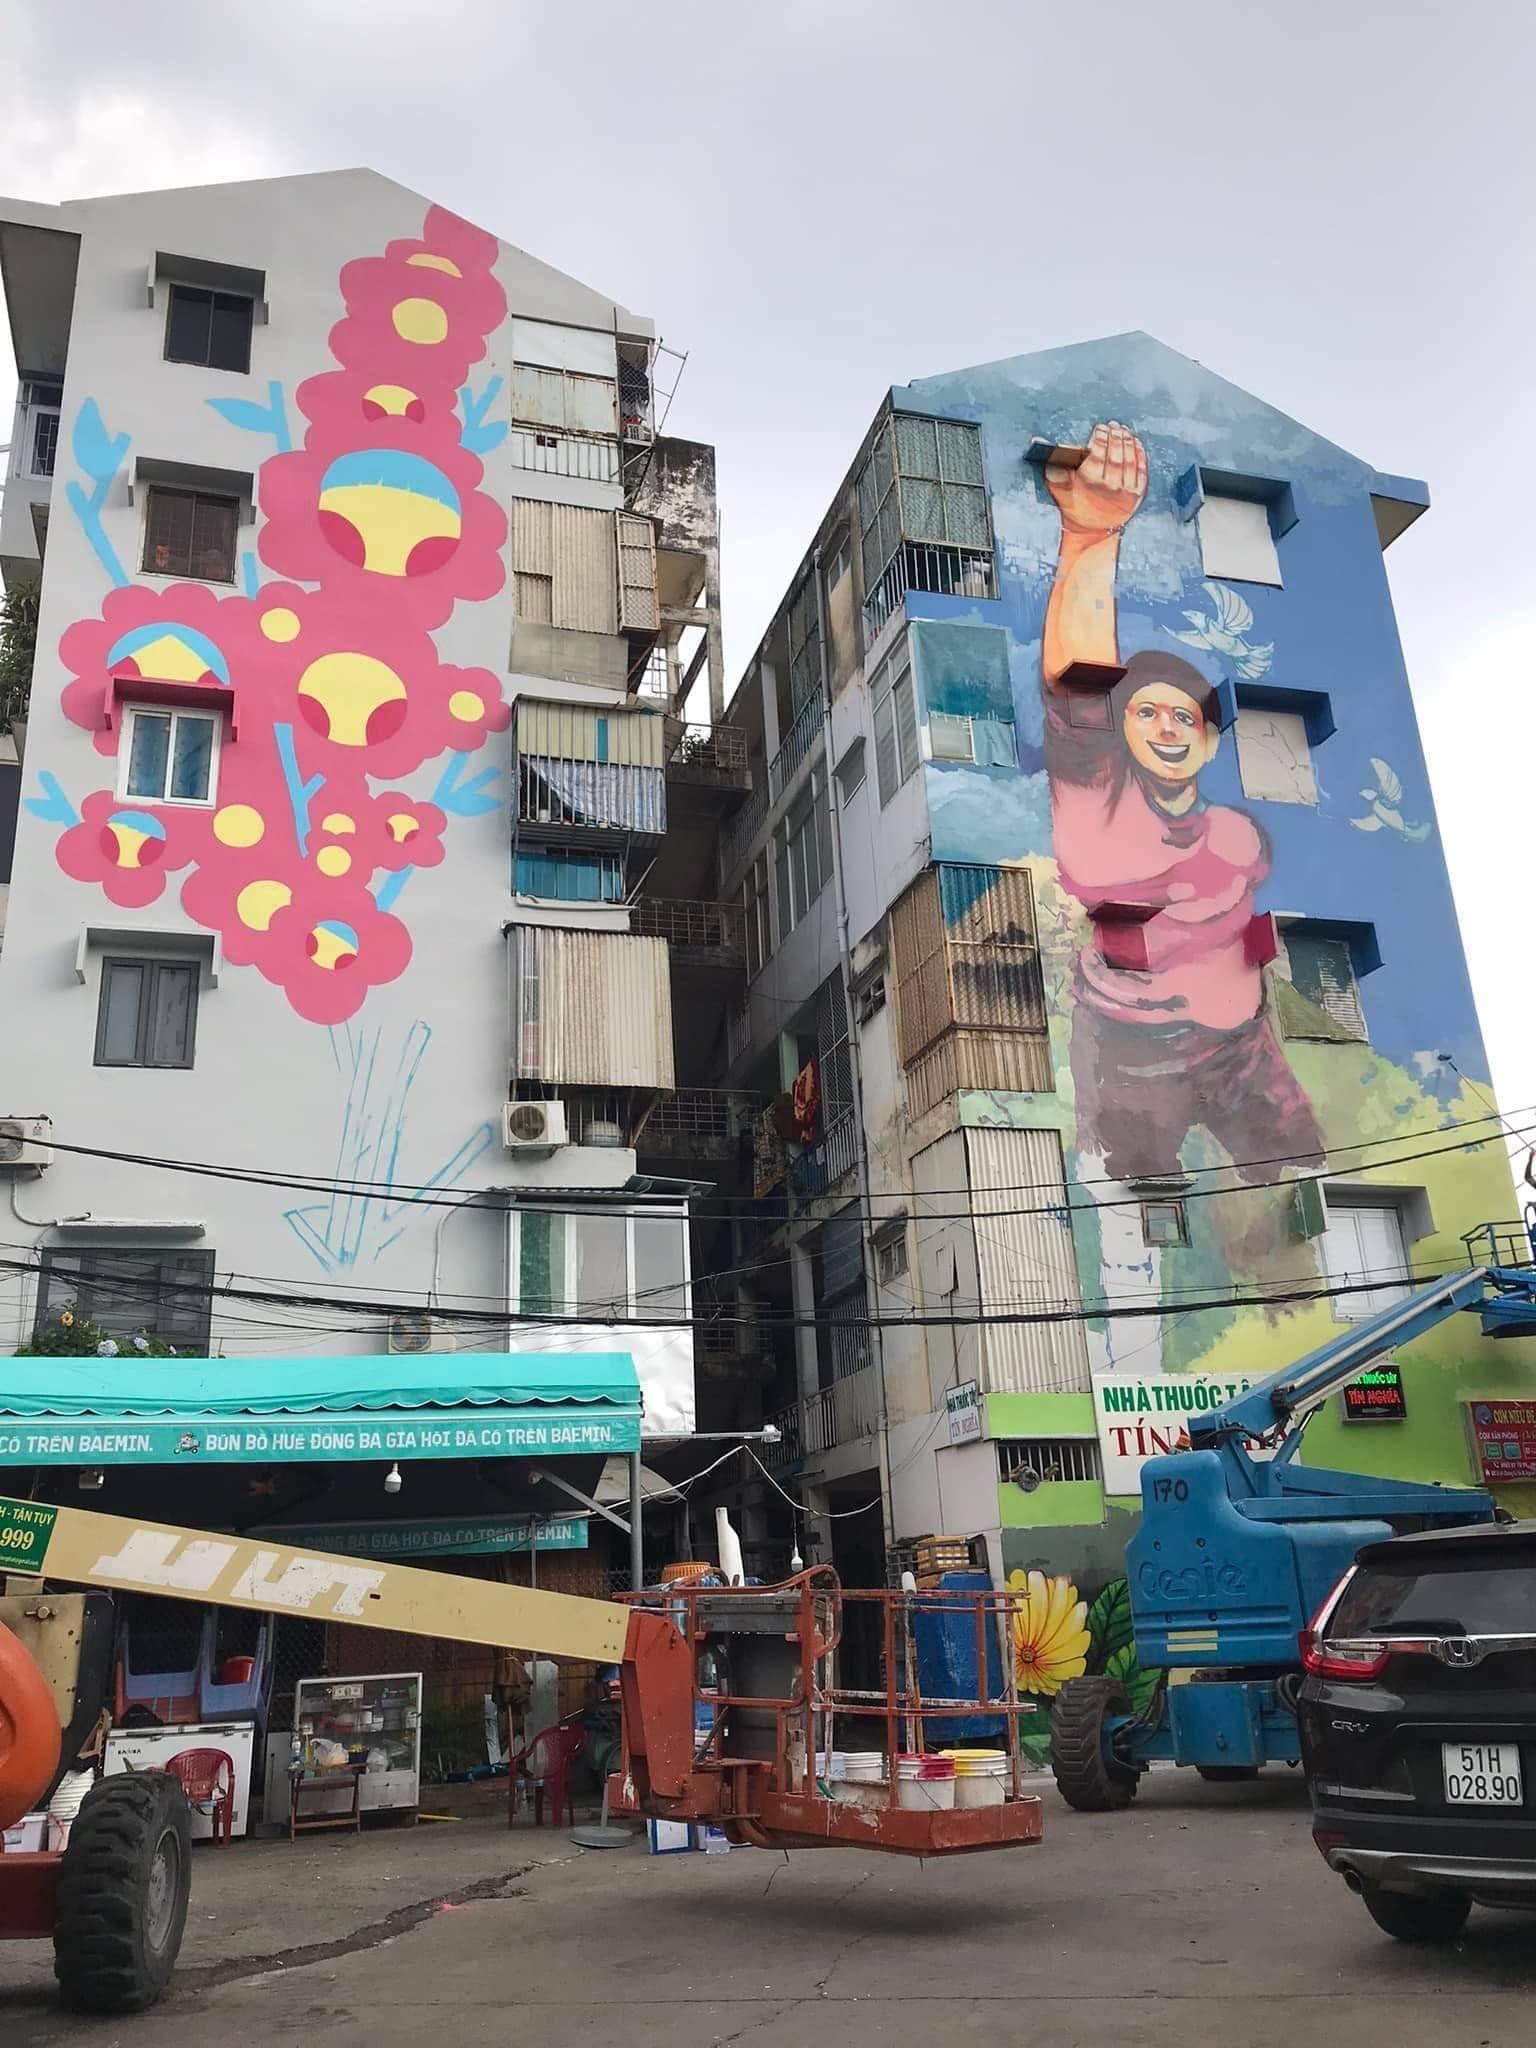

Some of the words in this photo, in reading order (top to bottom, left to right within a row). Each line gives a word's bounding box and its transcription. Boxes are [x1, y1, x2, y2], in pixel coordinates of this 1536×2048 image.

[1103, 1380, 1152, 1412] NHÀ
[1152, 1377, 1223, 1411] THUỐC
[26, 1434, 75, 1453] TRÊN
[79, 1433, 154, 1453] BAEMIN.
[246, 1427, 268, 1451] BÒ
[359, 1432, 382, 1448] BA
[386, 1431, 417, 1447] GIA
[506, 1428, 548, 1444] TRÊN
[551, 1426, 615, 1443] BAEMIN.
[1109, 1418, 1173, 1457] TÍN
[1153, 1478, 1189, 1503] 170
[1460, 1747, 1502, 1773] 51H
[1448, 1774, 1519, 1801] 028.90
